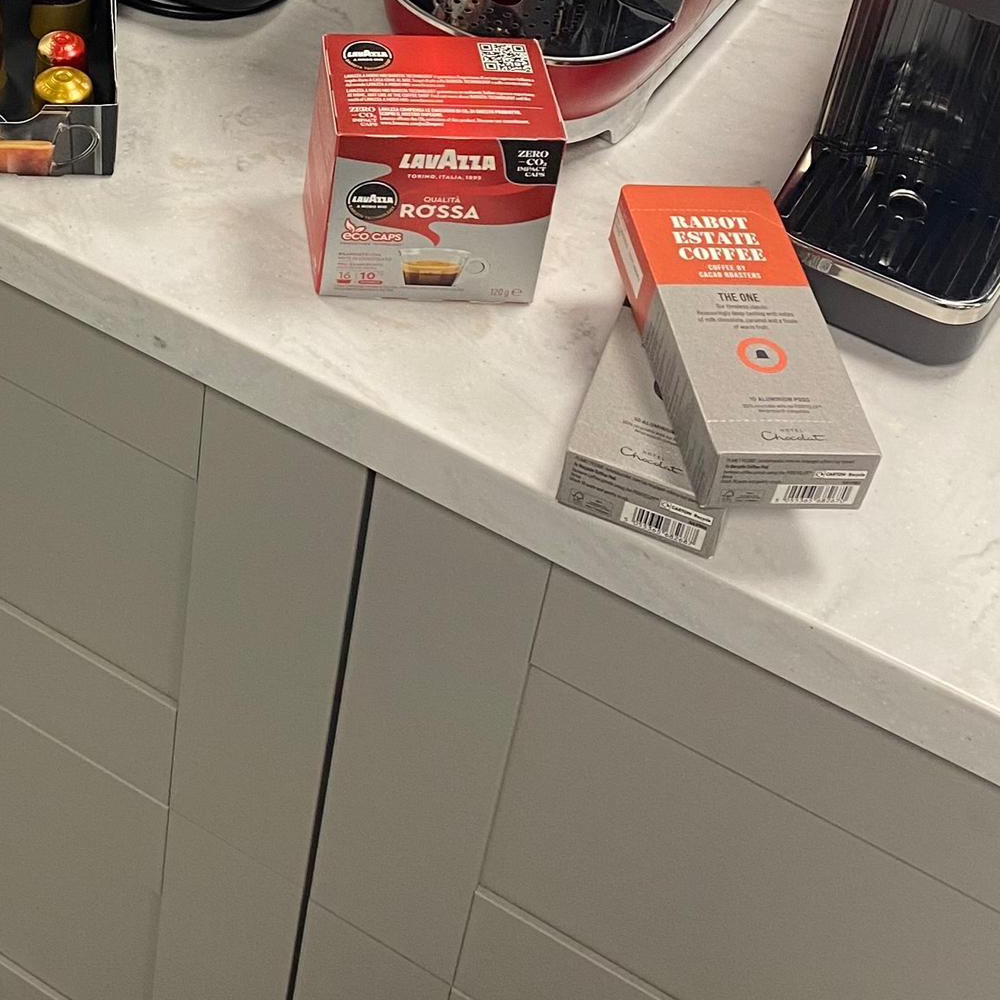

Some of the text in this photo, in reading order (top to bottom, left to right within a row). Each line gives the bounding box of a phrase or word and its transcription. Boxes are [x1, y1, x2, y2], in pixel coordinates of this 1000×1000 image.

[517, 150, 549, 158] ZERO
[398, 149, 496, 171] LAVAZZA
[352, 193, 394, 204] LAVAZZA
[423, 195, 461, 204] QUALITÀ
[400, 203, 479, 220] ROSSA
[670, 215, 748, 230] RABOT
[371, 232, 402, 241] CAPS
[672, 231, 760, 246] ESTATE
[678, 246, 767, 262] COFFEE
[339, 271, 376, 280] 16 10
[717, 292, 761, 303] THE ONE
